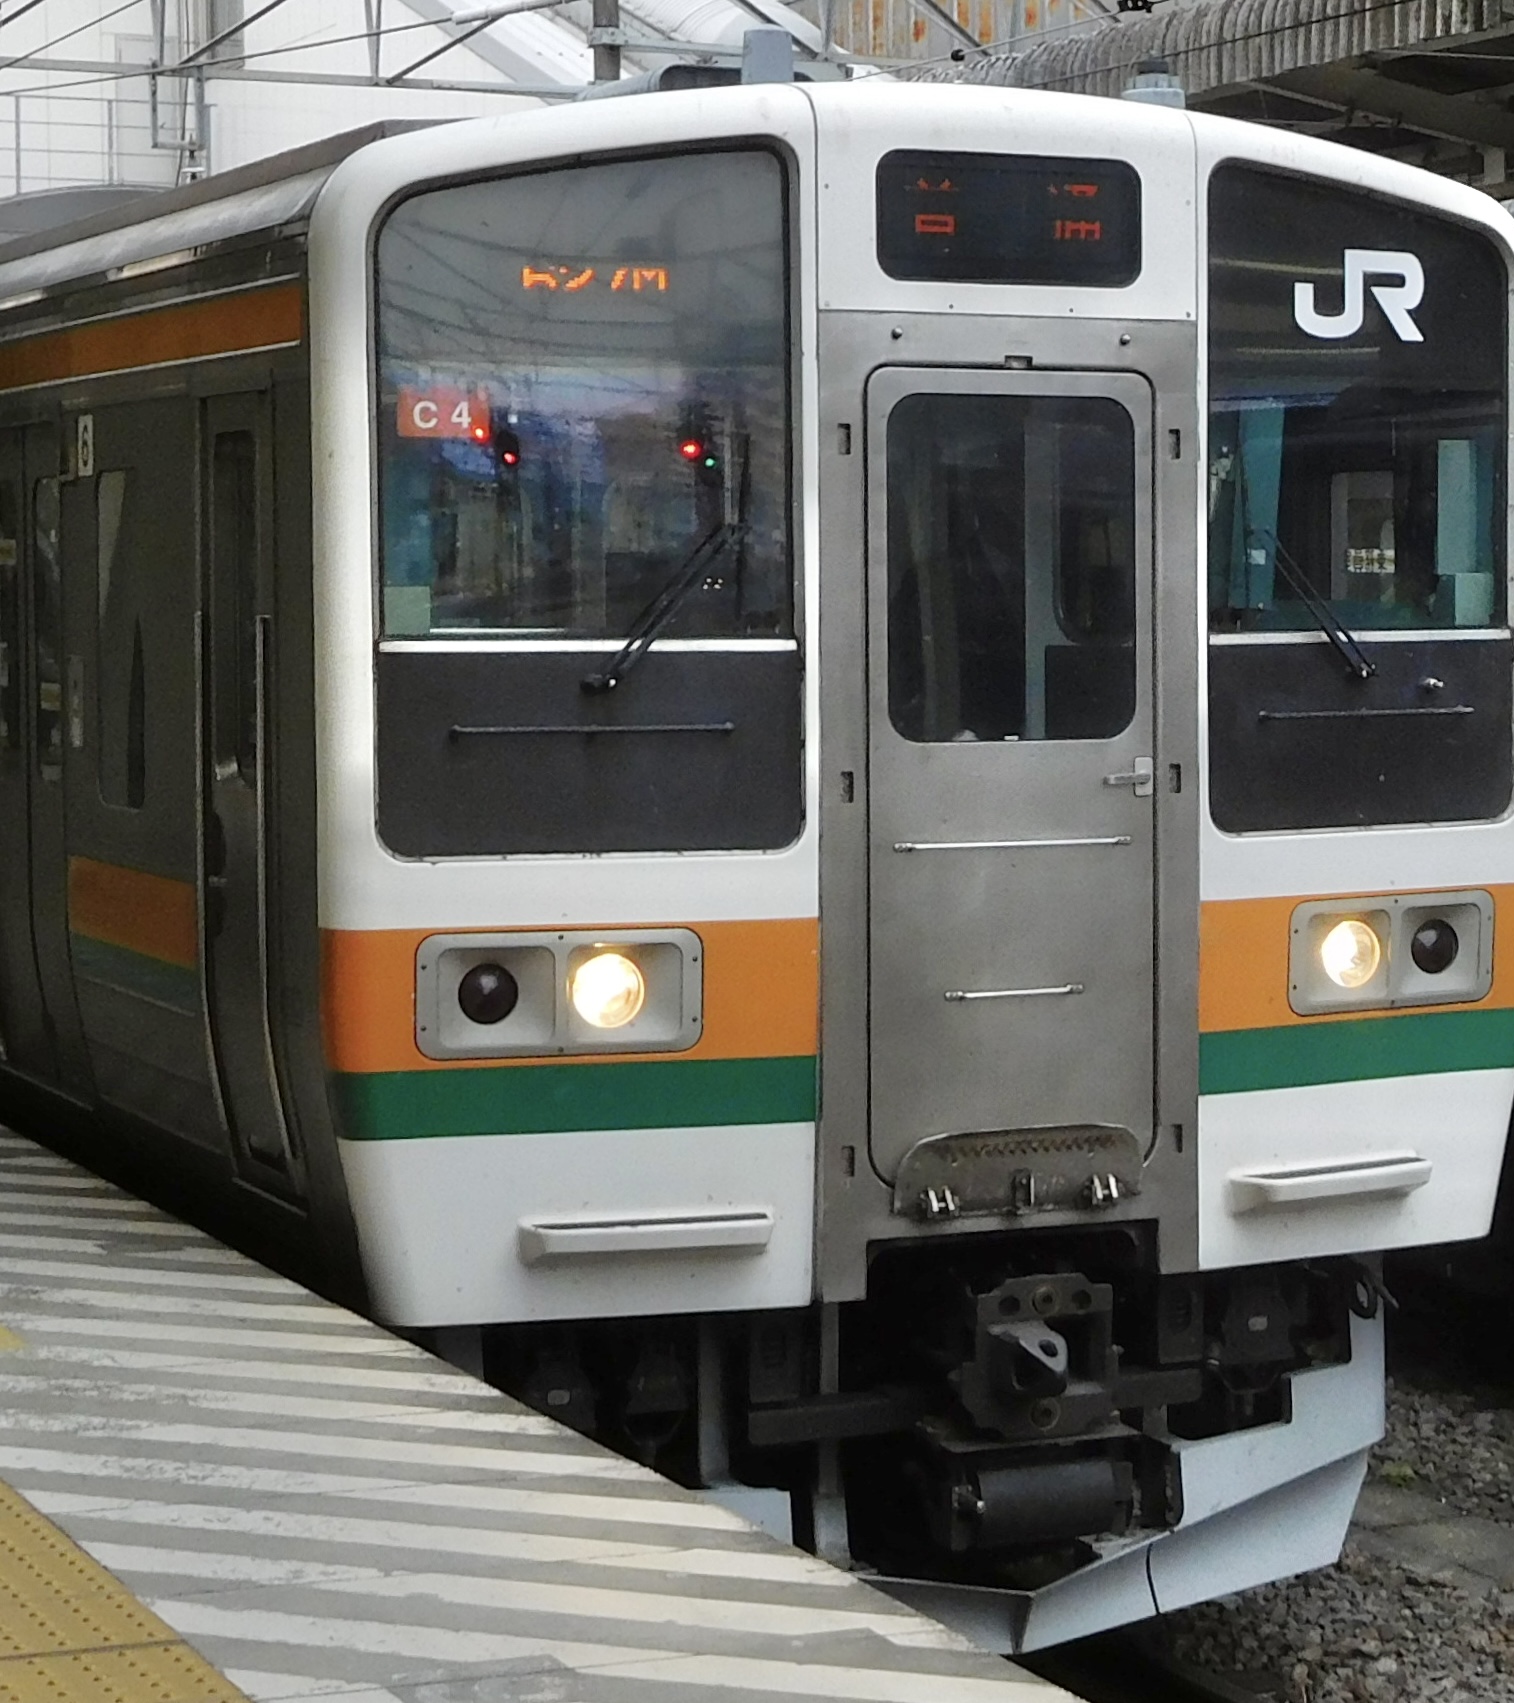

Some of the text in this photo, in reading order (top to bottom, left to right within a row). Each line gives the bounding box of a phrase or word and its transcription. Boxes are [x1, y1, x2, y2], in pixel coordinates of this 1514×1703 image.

[1294, 248, 1425, 342] JR
[412, 400, 472, 429] C 4
[82, 423, 90, 468] 6
